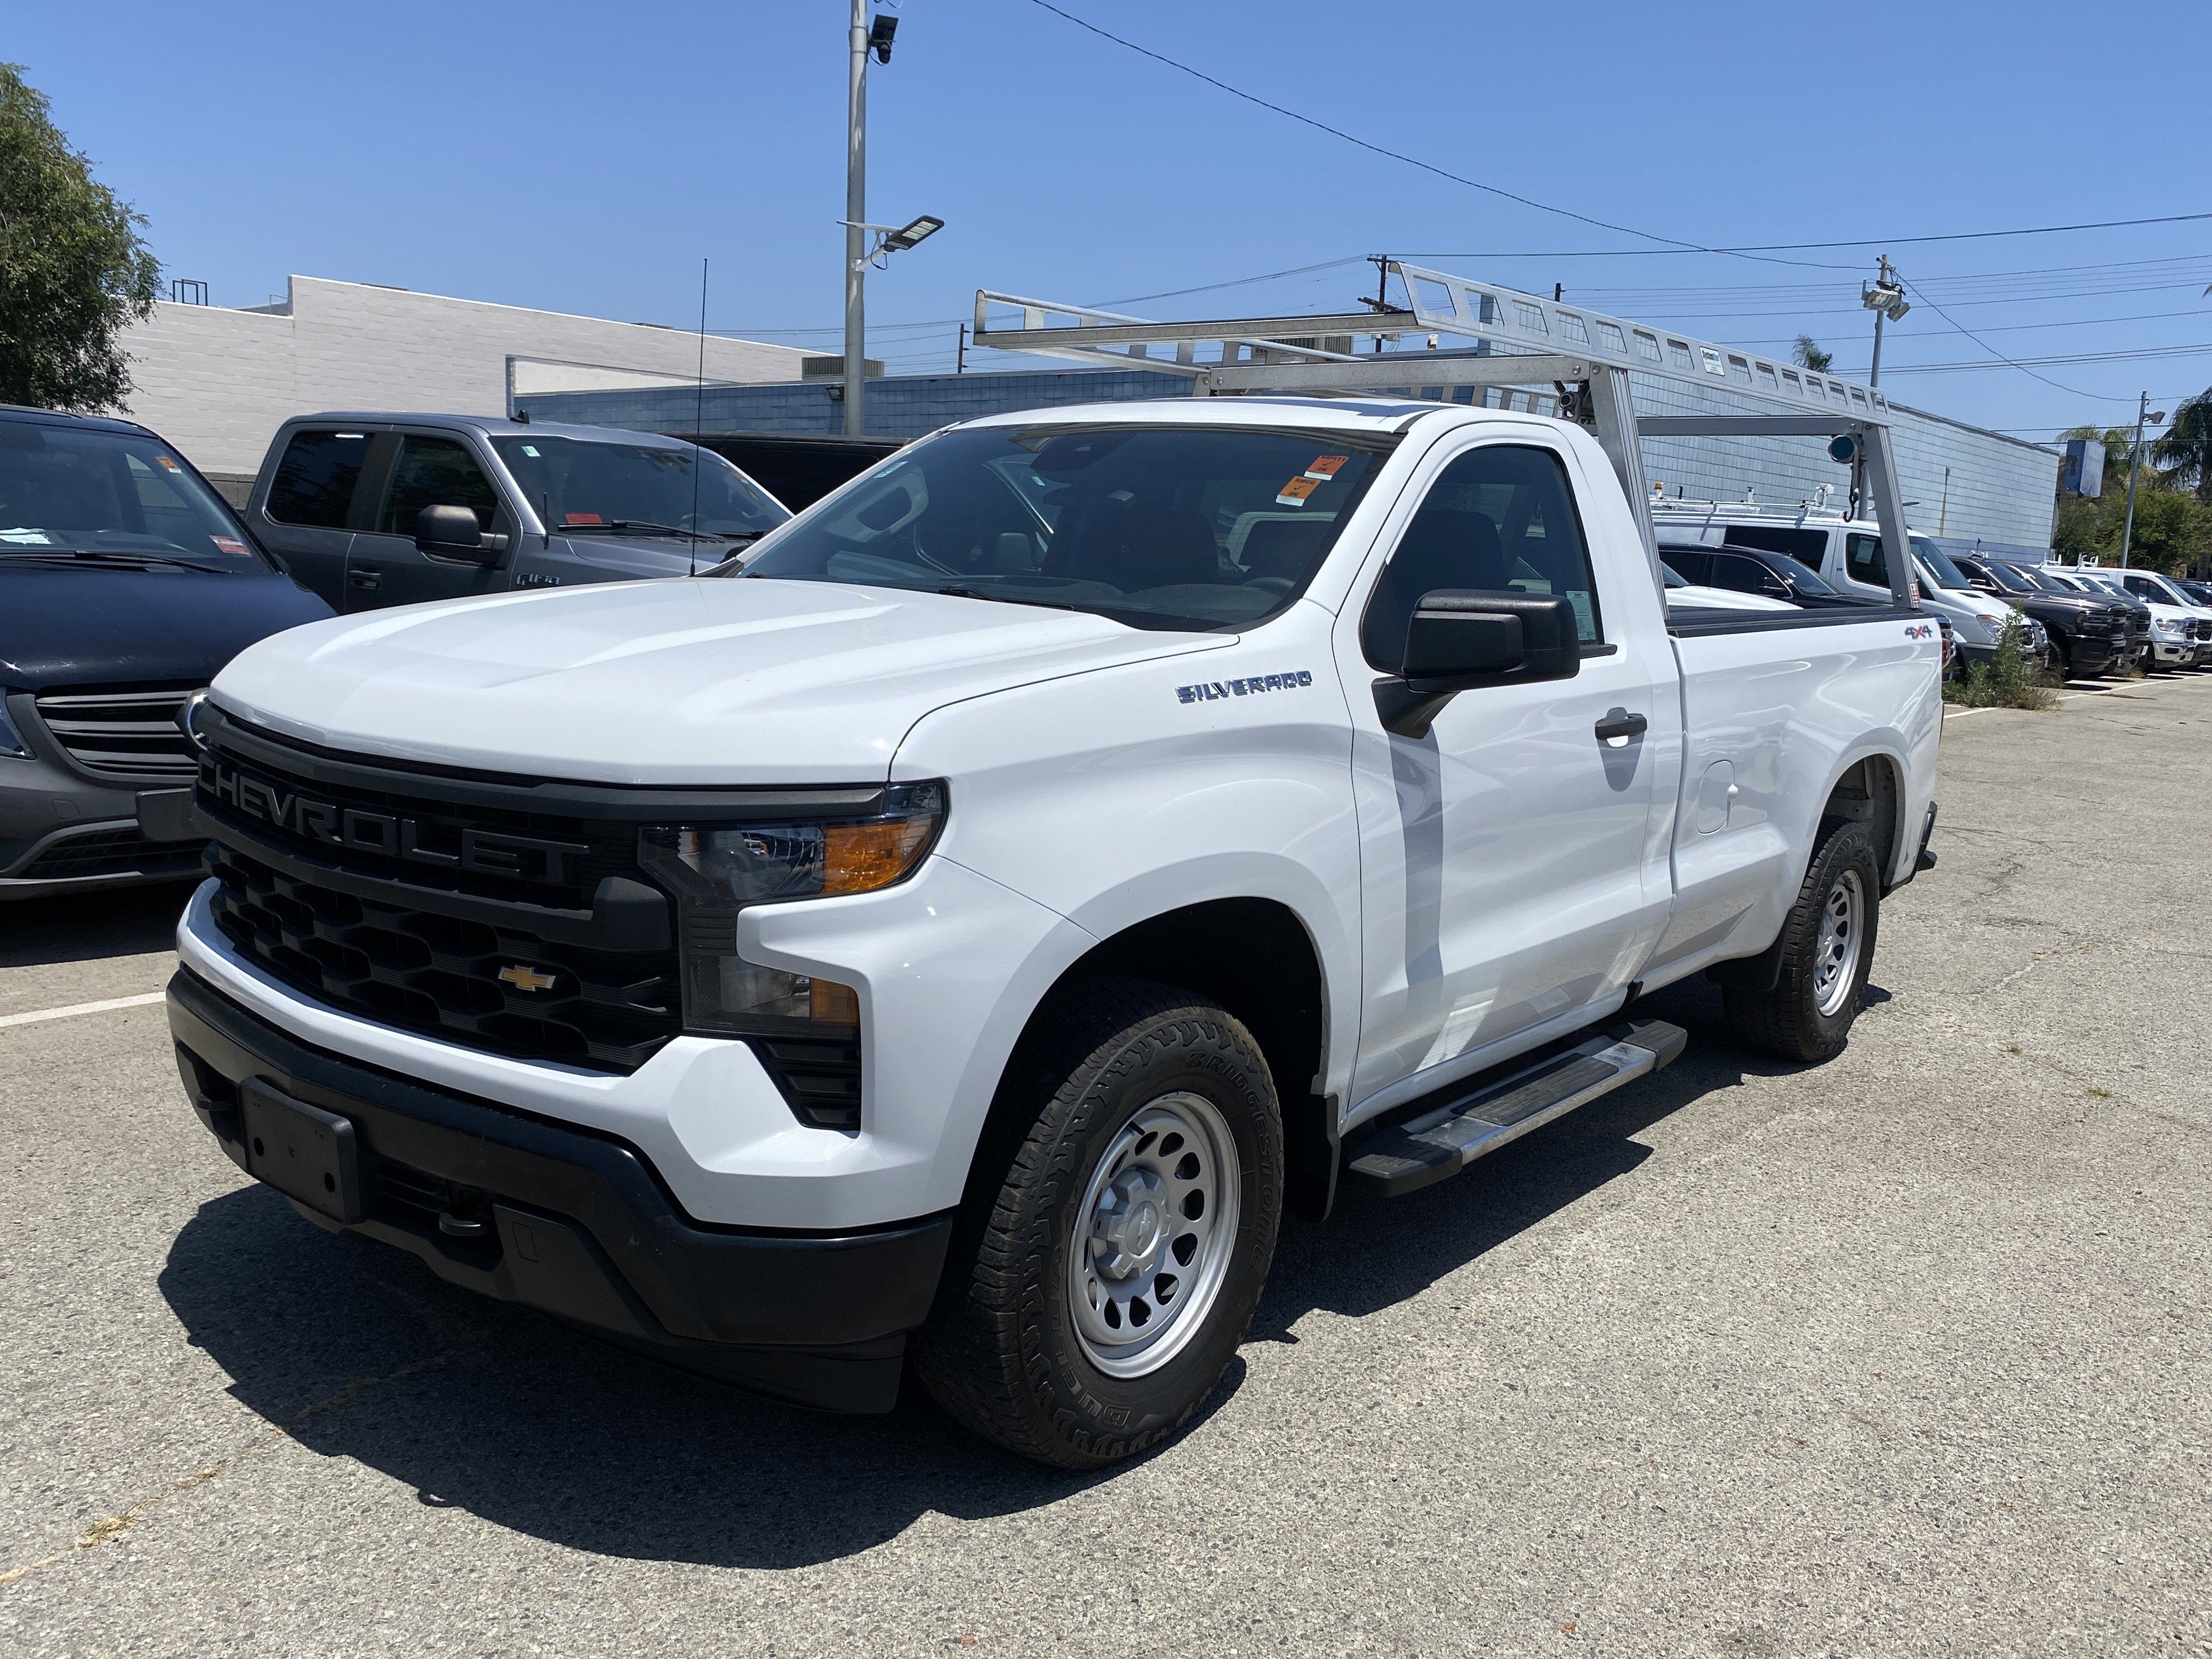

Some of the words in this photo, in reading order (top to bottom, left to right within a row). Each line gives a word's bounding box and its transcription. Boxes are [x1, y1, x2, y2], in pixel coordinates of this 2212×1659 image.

[1175, 670, 1312, 704] SILVERADO
[198, 754, 590, 881] CHEVROLET
[1181, 1050, 1273, 1275] BRIDGESTONE
